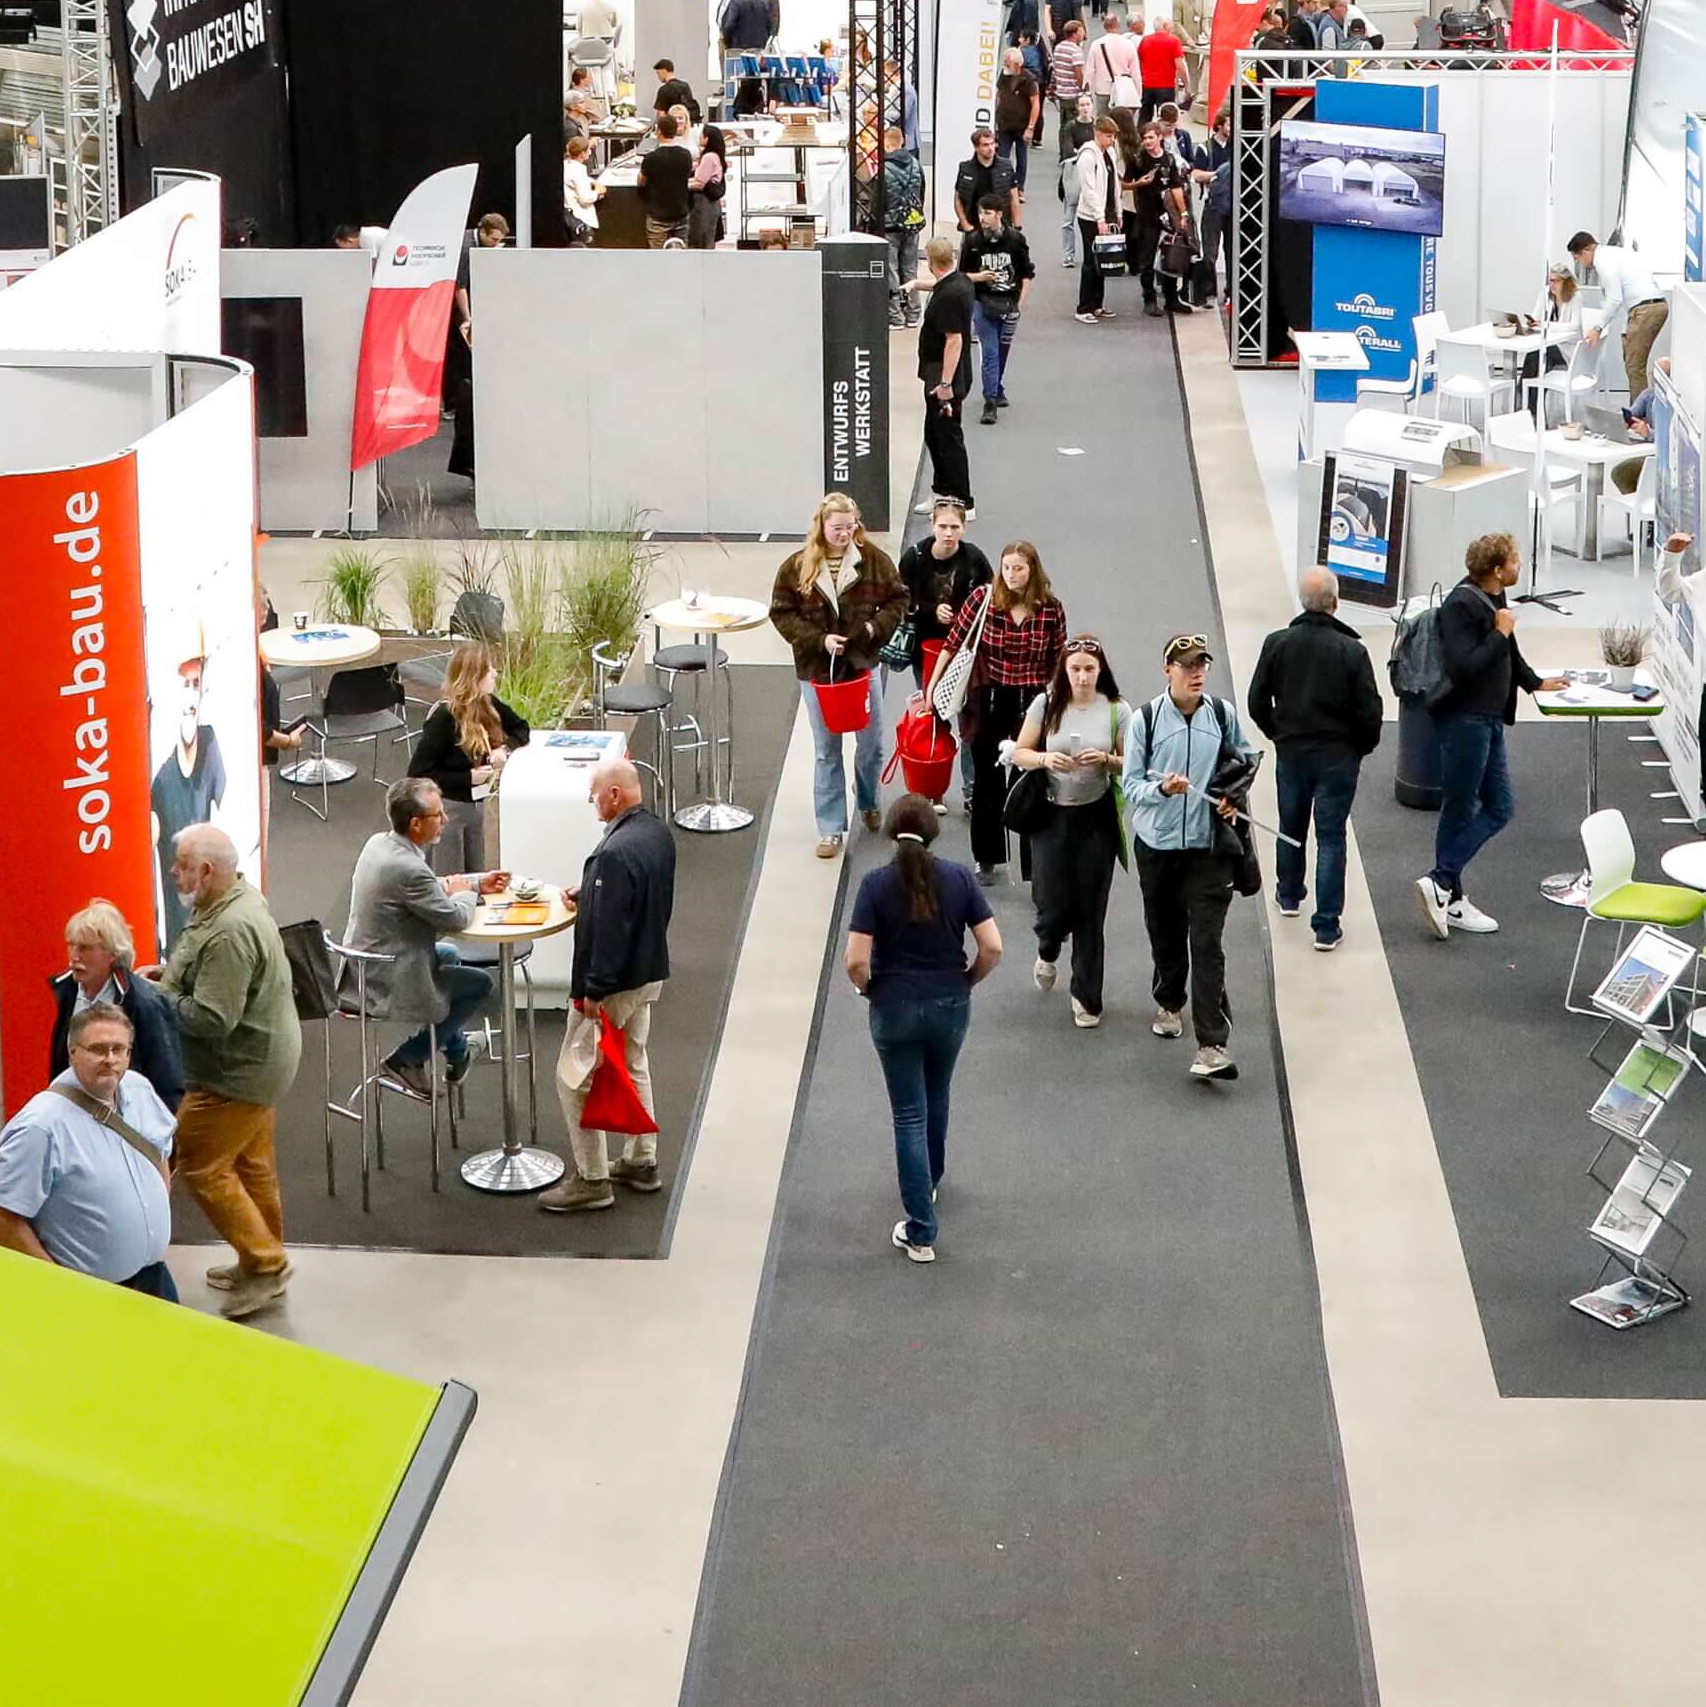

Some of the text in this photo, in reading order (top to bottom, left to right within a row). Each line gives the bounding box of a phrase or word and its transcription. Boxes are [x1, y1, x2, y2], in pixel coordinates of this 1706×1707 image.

[165, 8, 245, 92] BAUWESEN
[976, 21, 997, 101] DABEI!
[833, 380, 849, 482] ENTWURFS
[854, 346, 871, 458] WERKSTATT
[53, 490, 112, 855] soka-bau.de
